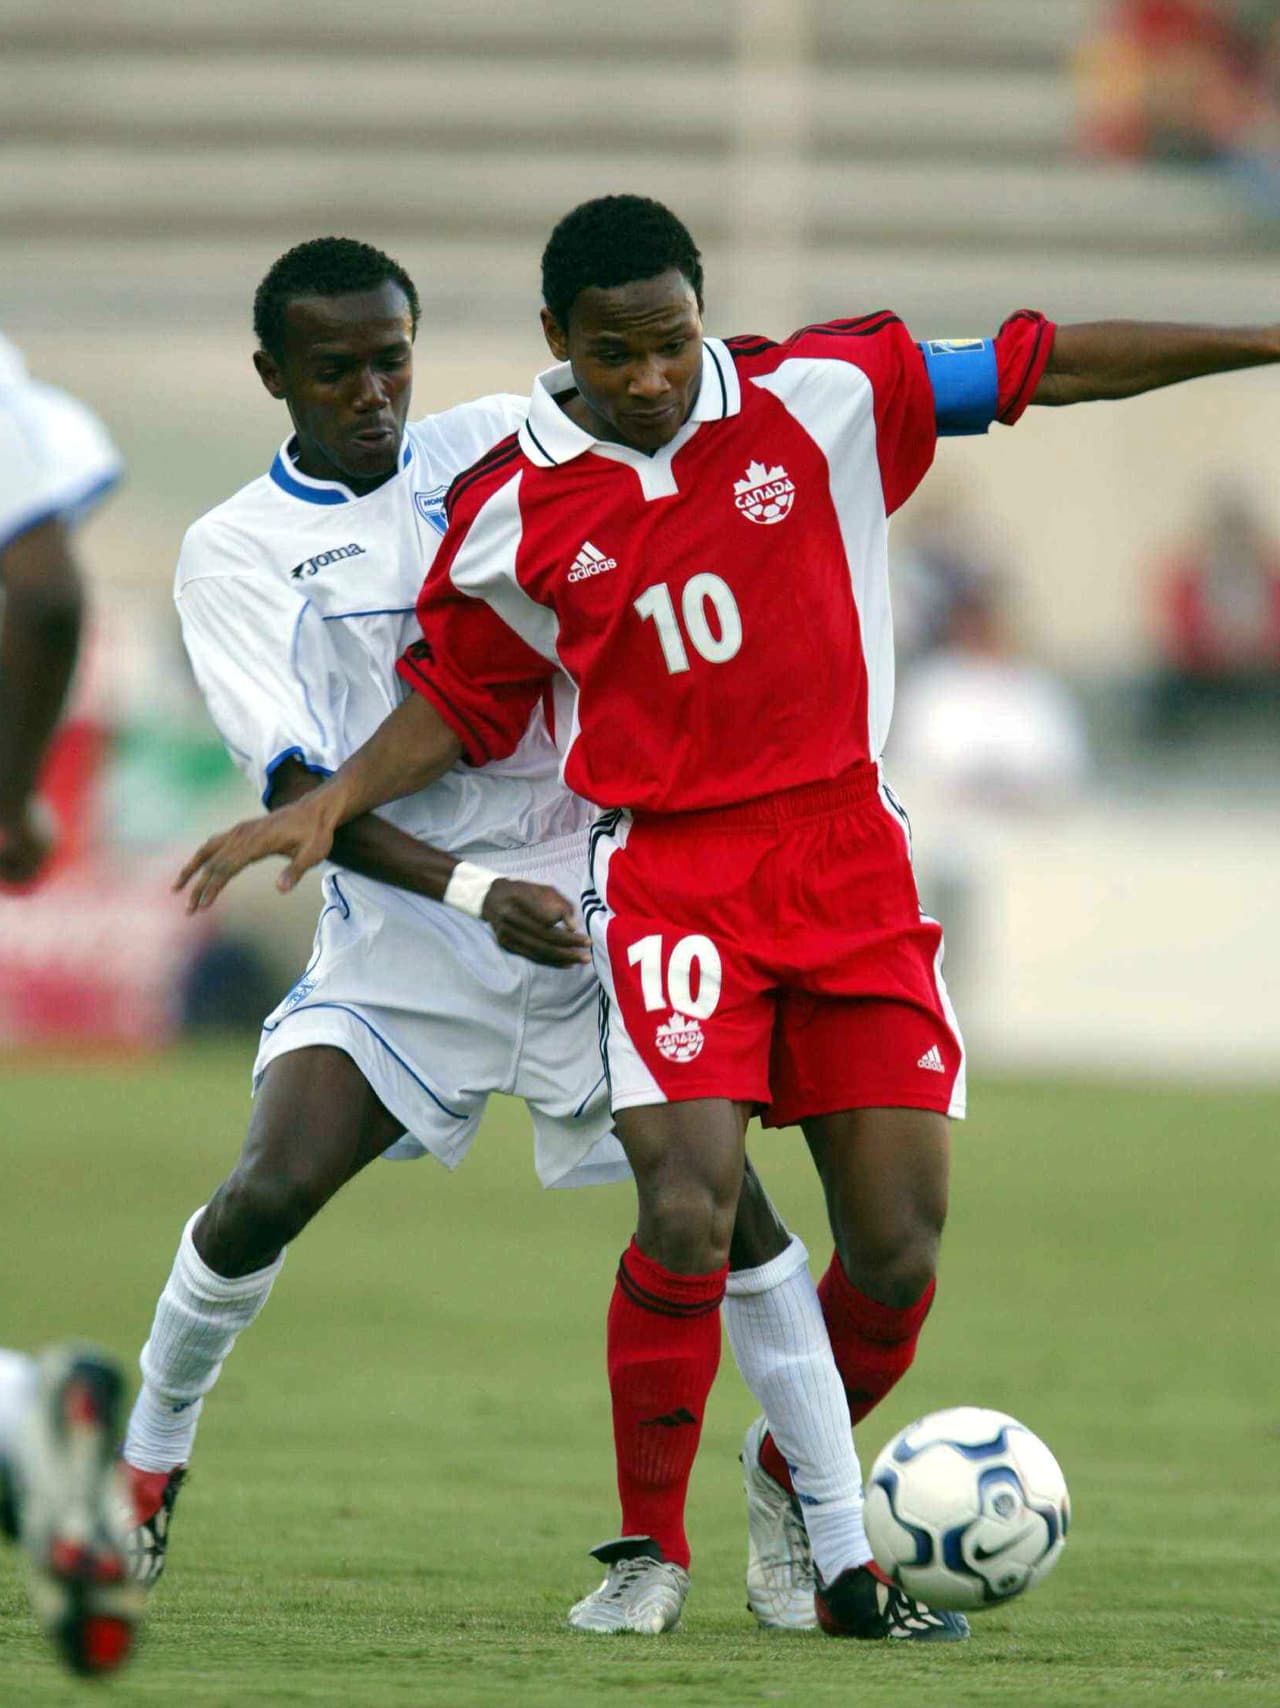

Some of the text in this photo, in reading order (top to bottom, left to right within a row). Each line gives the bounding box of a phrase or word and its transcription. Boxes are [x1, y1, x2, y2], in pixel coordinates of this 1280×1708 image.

[423, 496, 446, 506] HON
[735, 478, 796, 509] CANADA
[303, 543, 366, 576] Joma
[567, 558, 618, 583] adidas
[633, 572, 743, 676] 10
[627, 934, 722, 1020] 10
[655, 1030, 704, 1048] CANADA
